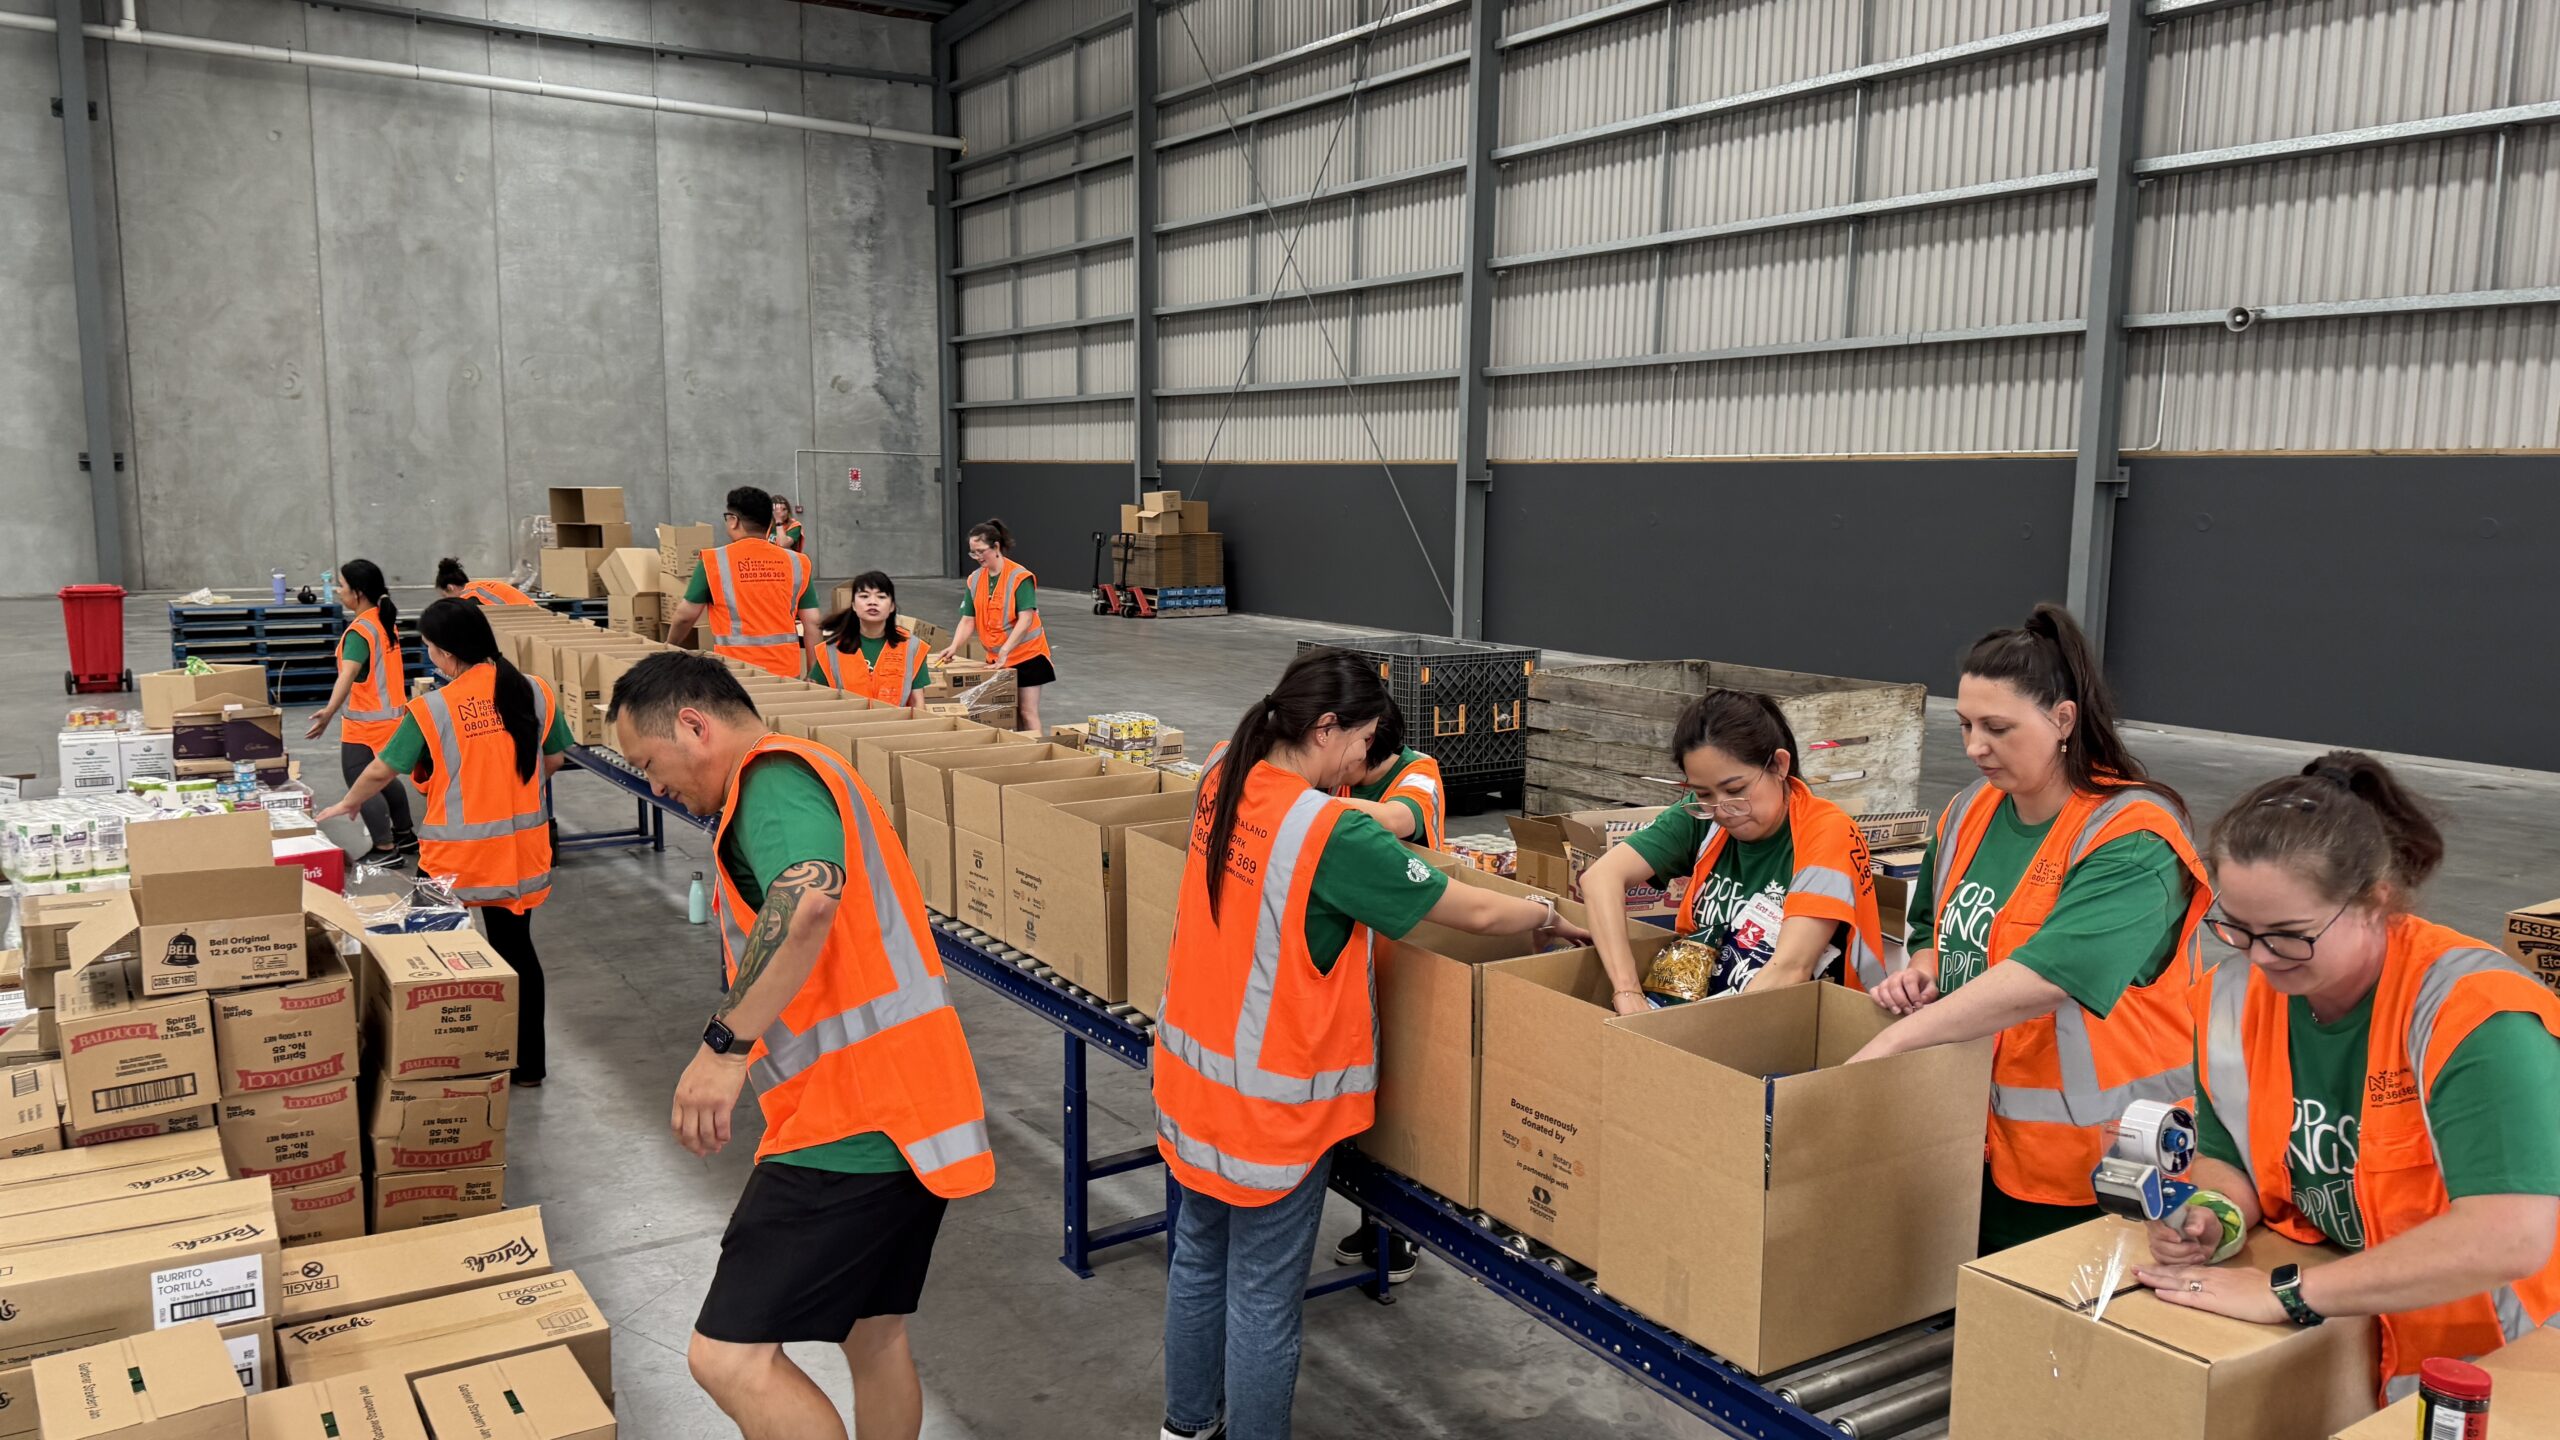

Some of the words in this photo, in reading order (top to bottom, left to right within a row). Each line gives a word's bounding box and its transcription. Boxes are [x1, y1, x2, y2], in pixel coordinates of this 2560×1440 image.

[464, 719, 489, 732] 0800
[1236, 853, 1257, 874] 369
[209, 938, 228, 946] Bell
[230, 934, 270, 945] Original
[168, 945, 196, 956] BELL
[231, 946, 253, 954] 60's
[253, 944, 271, 952] Tea
[274, 942, 298, 951] Bags
[417, 983, 497, 1002] BALDUCCI
[285, 992, 340, 1009] BALDUCCI
[441, 1004, 472, 1015] Spirali
[166, 1014, 196, 1026] Spirali
[459, 1014, 472, 1022] 55
[166, 1025, 183, 1033] No.
[185, 1022, 197, 1030] 55
[80, 1025, 152, 1047] BALDUCCI
[272, 1046, 286, 1054] 55
[288, 1042, 306, 1050] No.
[273, 1051, 306, 1064] Spirali
[484, 1049, 510, 1058] Spirali
[405, 1058, 456, 1069] BALDUCCI
[247, 1061, 334, 1088] BALDUCCI
[288, 1090, 342, 1108] BALDUCCI
[168, 1114, 199, 1126] Spirali
[226, 1109, 256, 1119] Spirali
[1510, 1098, 1533, 1115] Boxes
[1534, 1110, 1578, 1136] generously
[429, 1129, 441, 1137] 55
[1521, 1116, 1553, 1137] donated
[1555, 1129, 1566, 1144] by
[428, 1136, 460, 1146] Spirali
[1502, 1129, 1520, 1145] Rotary
[274, 1145, 288, 1154] 55
[290, 1142, 308, 1150] No.
[275, 1150, 309, 1163] Spirali
[402, 1147, 484, 1166] BALDUCCI
[1537, 1149, 1544, 1157] &
[1552, 1153, 1572, 1169] Rotary
[1522, 1163, 1556, 1184] partnership
[1555, 1180, 1569, 1190] with
[465, 1181, 492, 1190] Spirali
[392, 1187, 454, 1201] BALDUCCI
[296, 1193, 350, 1210] BALDUCCI
[1527, 1197, 1557, 1217] PACKAGING
[461, 1235, 538, 1273] Farrah's
[157, 1268, 203, 1284] BURRITO
[158, 1278, 213, 1295] TORTILLAS
[283, 1279, 331, 1295] FRAGIL
[506, 1281, 559, 1298] FRAGILE
[289, 1316, 376, 1345] Farrah's
